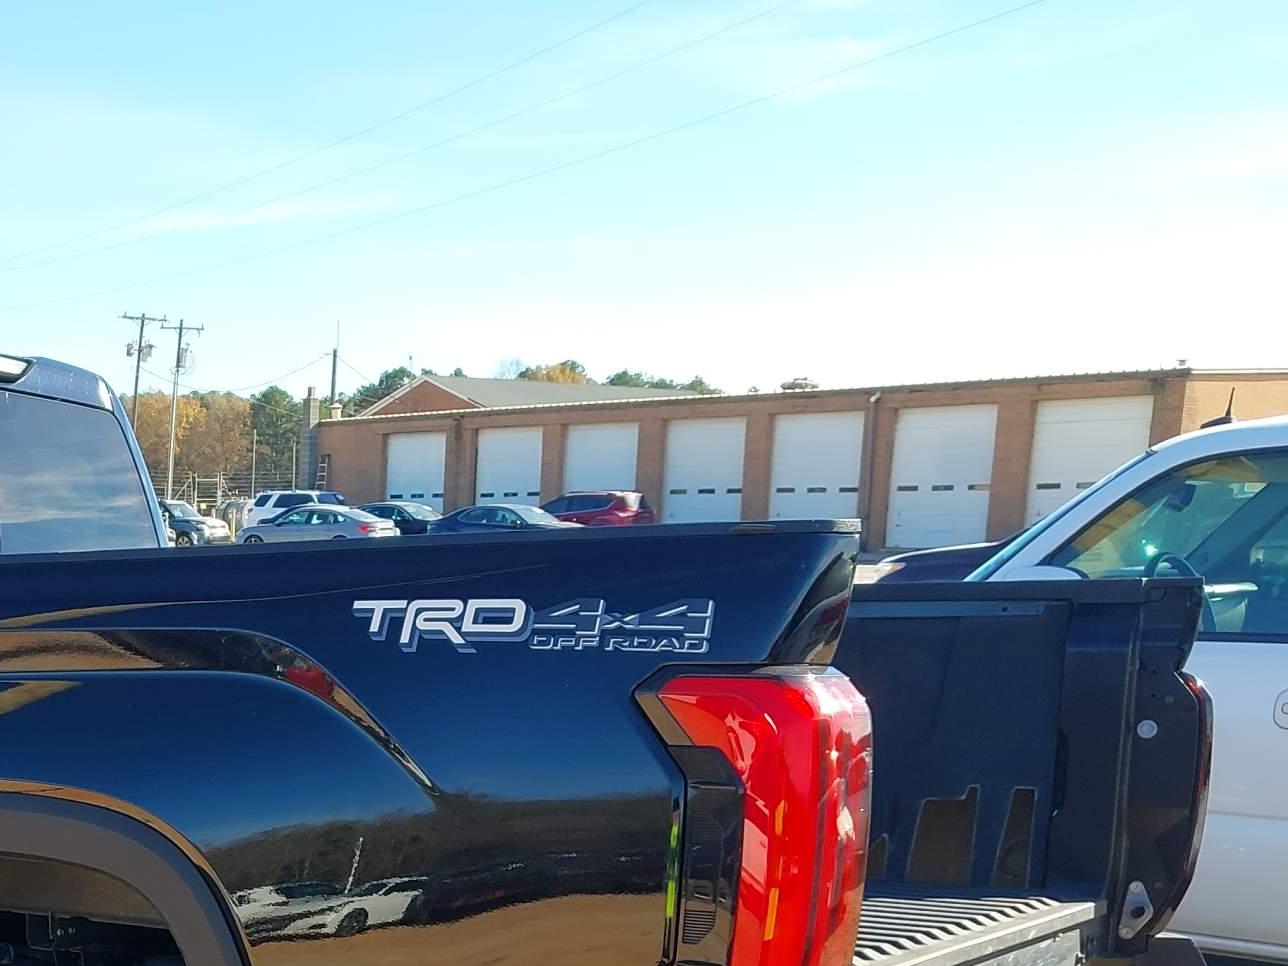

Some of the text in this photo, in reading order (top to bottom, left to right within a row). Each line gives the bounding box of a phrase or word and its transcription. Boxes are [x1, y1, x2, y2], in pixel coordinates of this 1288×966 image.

[352, 598, 534, 653] TRD
[529, 635, 710, 653] OFF ROAD
